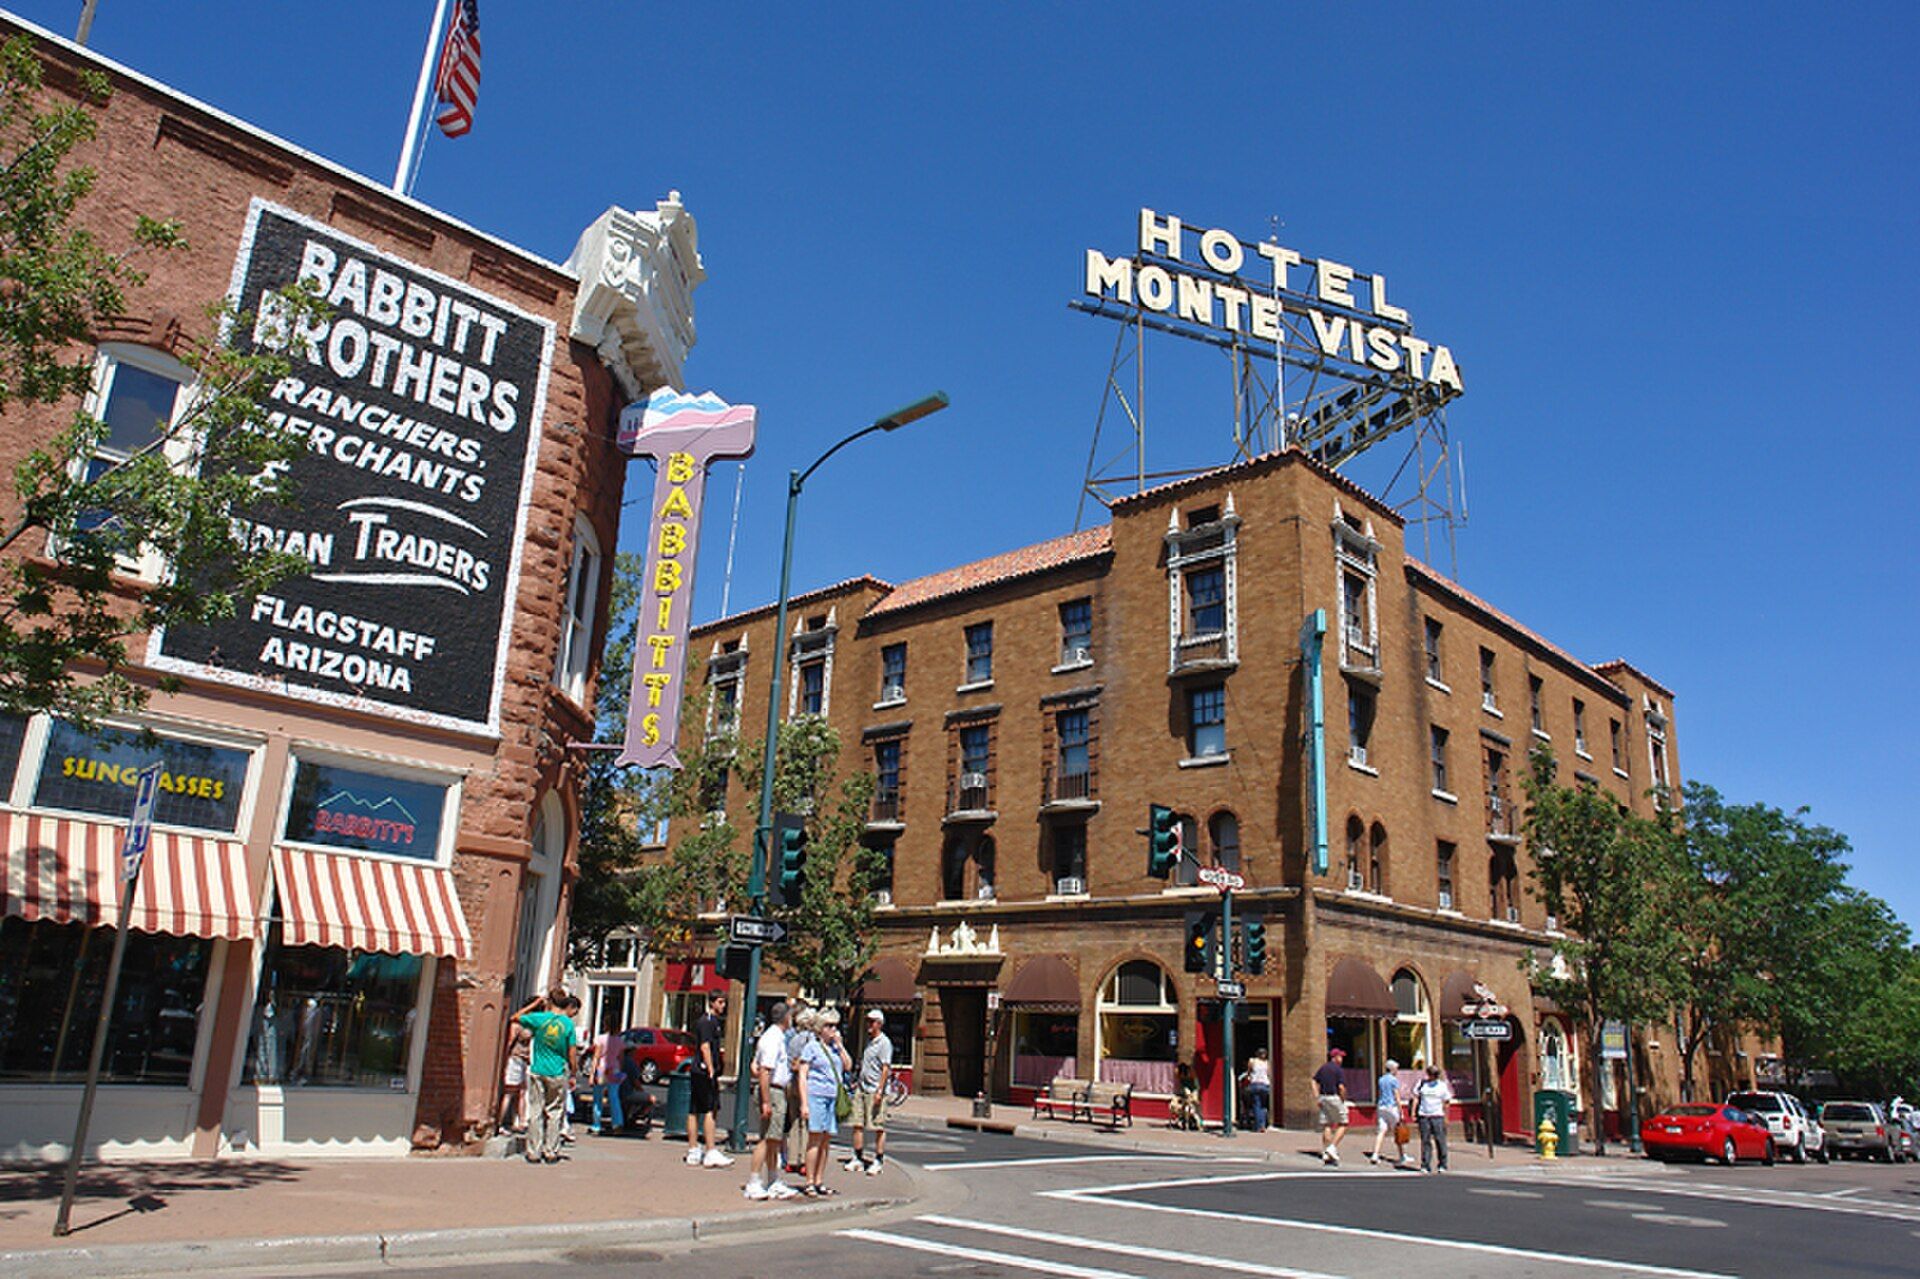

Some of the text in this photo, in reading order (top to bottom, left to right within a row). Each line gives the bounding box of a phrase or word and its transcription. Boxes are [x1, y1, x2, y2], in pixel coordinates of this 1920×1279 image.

[296, 239, 508, 366] BABBITT
[1139, 208, 1408, 323] HOTEL
[252, 289, 519, 432] BROTHERS
[1086, 248, 1464, 394] MONTE VISTA
[270, 377, 486, 468] RANCHERS,
[349, 512, 491, 592] TRADERS
[641, 452, 695, 746] BABBITTS
[251, 594, 436, 661] FLAGSTAFF
[259, 636, 412, 693] ARIZONA
[62, 756, 225, 800] SUNGASSES
